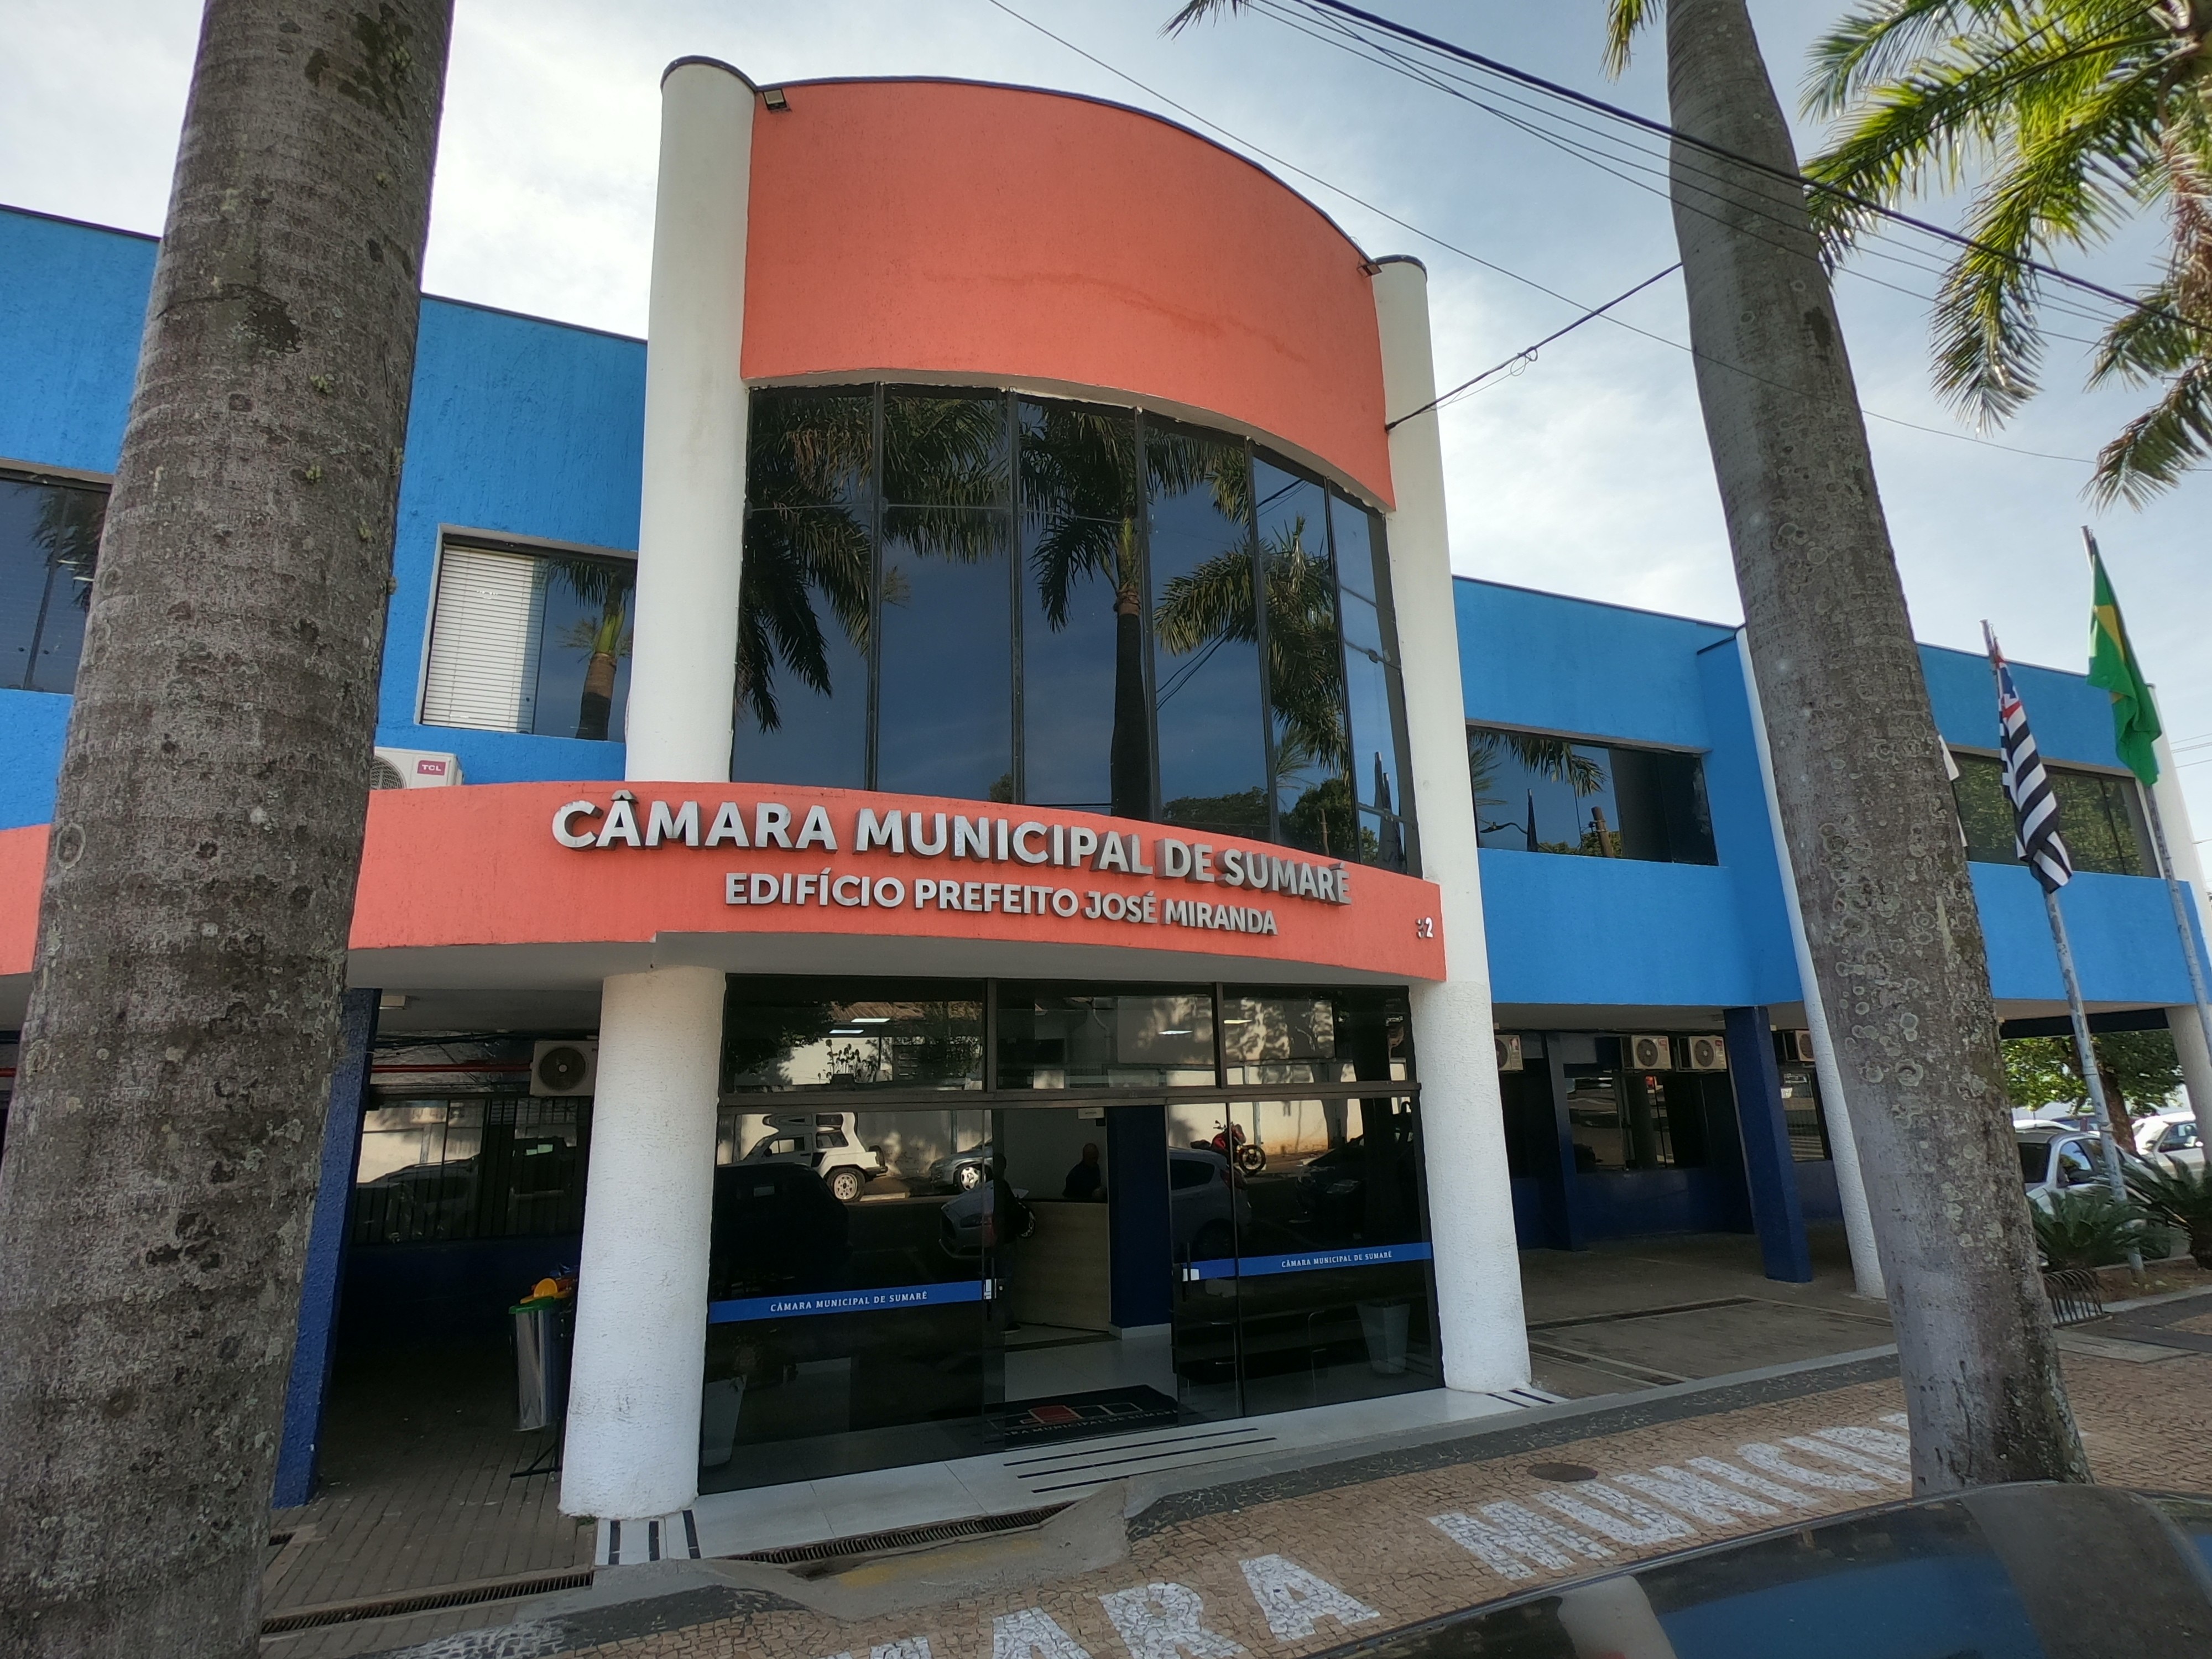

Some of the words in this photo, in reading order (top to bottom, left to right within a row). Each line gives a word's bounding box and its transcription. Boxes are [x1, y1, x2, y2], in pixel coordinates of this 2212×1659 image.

[552, 790, 838, 852] CÂMARA
[853, 808, 1153, 876] MUNICIPAL
[1156, 838, 1215, 884] DE
[1216, 848, 1352, 906] SUMARÉ
[726, 868, 905, 909] EDIFÍCIO
[915, 879, 1079, 919] PREFEITO
[1082, 890, 1158, 924] JOSÉ
[1162, 898, 1279, 936] MIRANDA
[1313, 1255, 1352, 1265] MUNICIPAL
[816, 1297, 870, 1308] MUNICIPAL
[874, 1296, 886, 1304] DE
